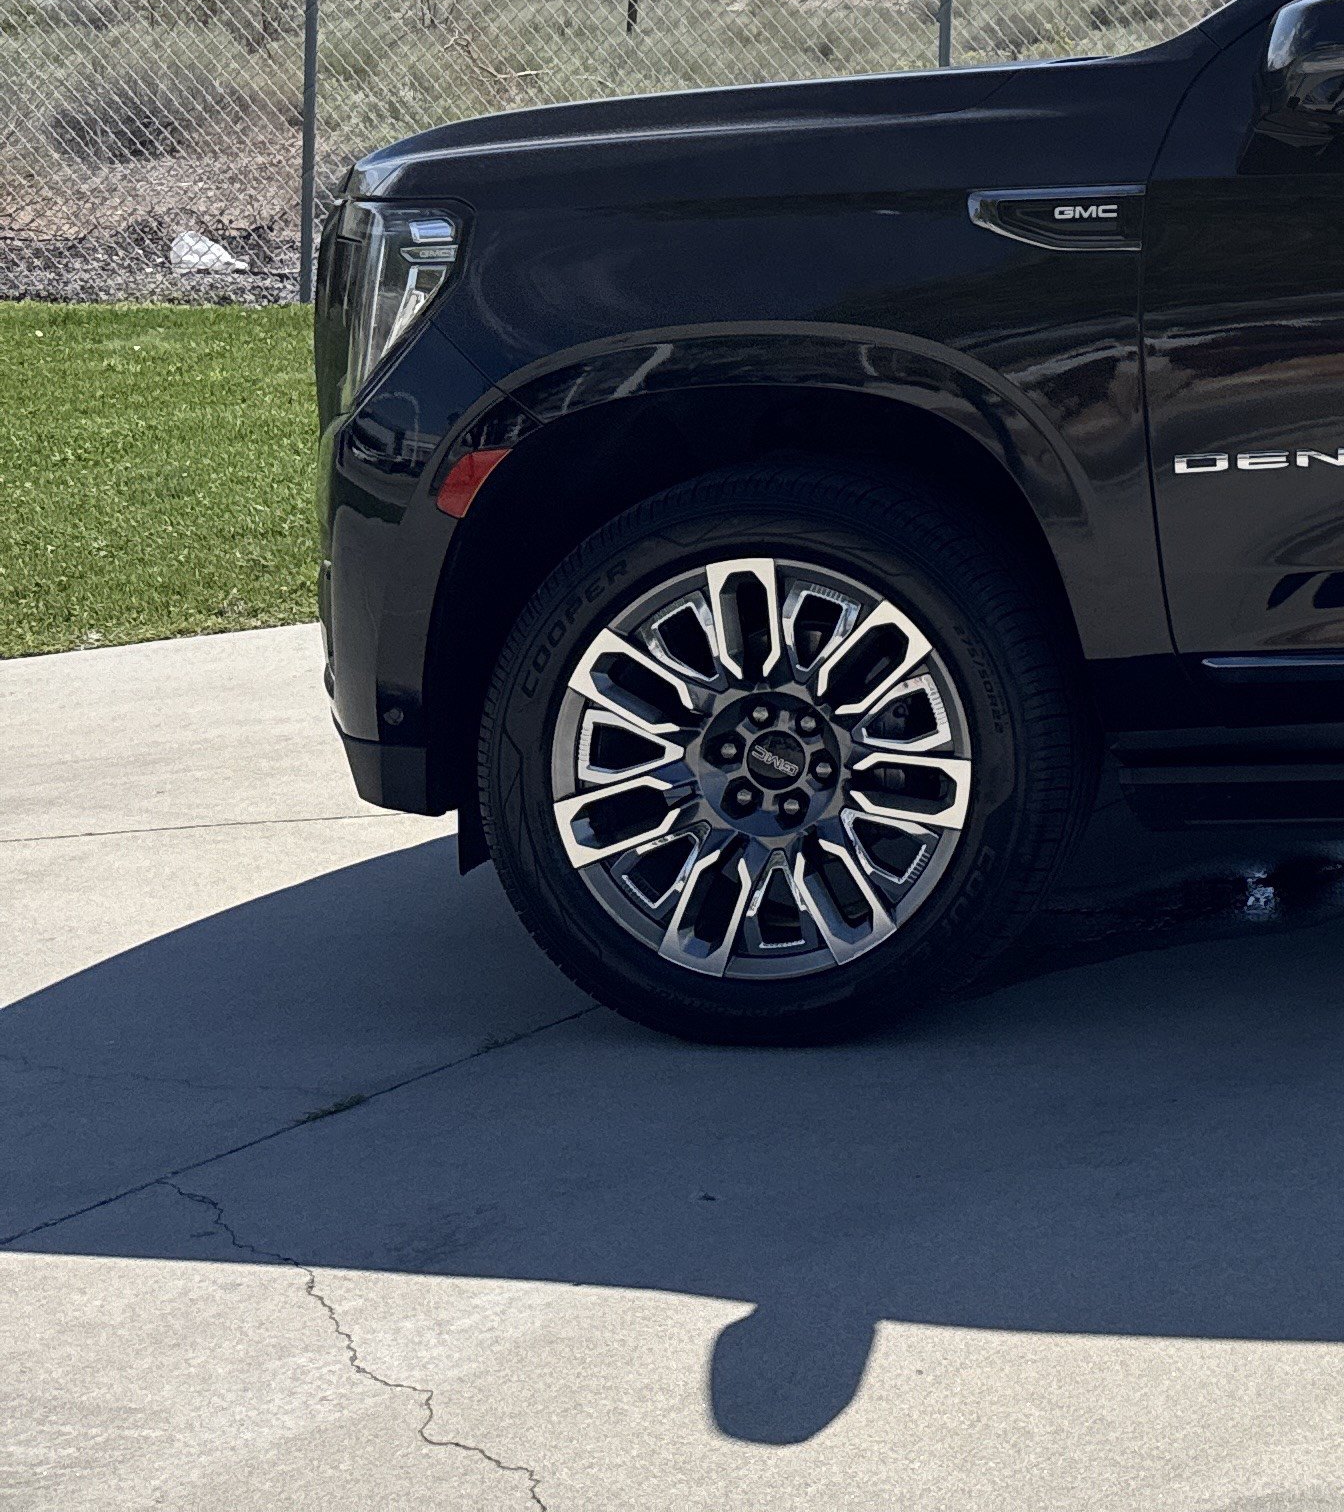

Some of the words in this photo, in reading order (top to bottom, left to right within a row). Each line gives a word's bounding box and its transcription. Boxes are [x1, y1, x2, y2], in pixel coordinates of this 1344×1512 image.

[1054, 204, 1118, 220] GMC
[419, 249, 449, 259] GMC
[521, 559, 628, 698] COOPER
[752, 744, 799, 777] GMC
